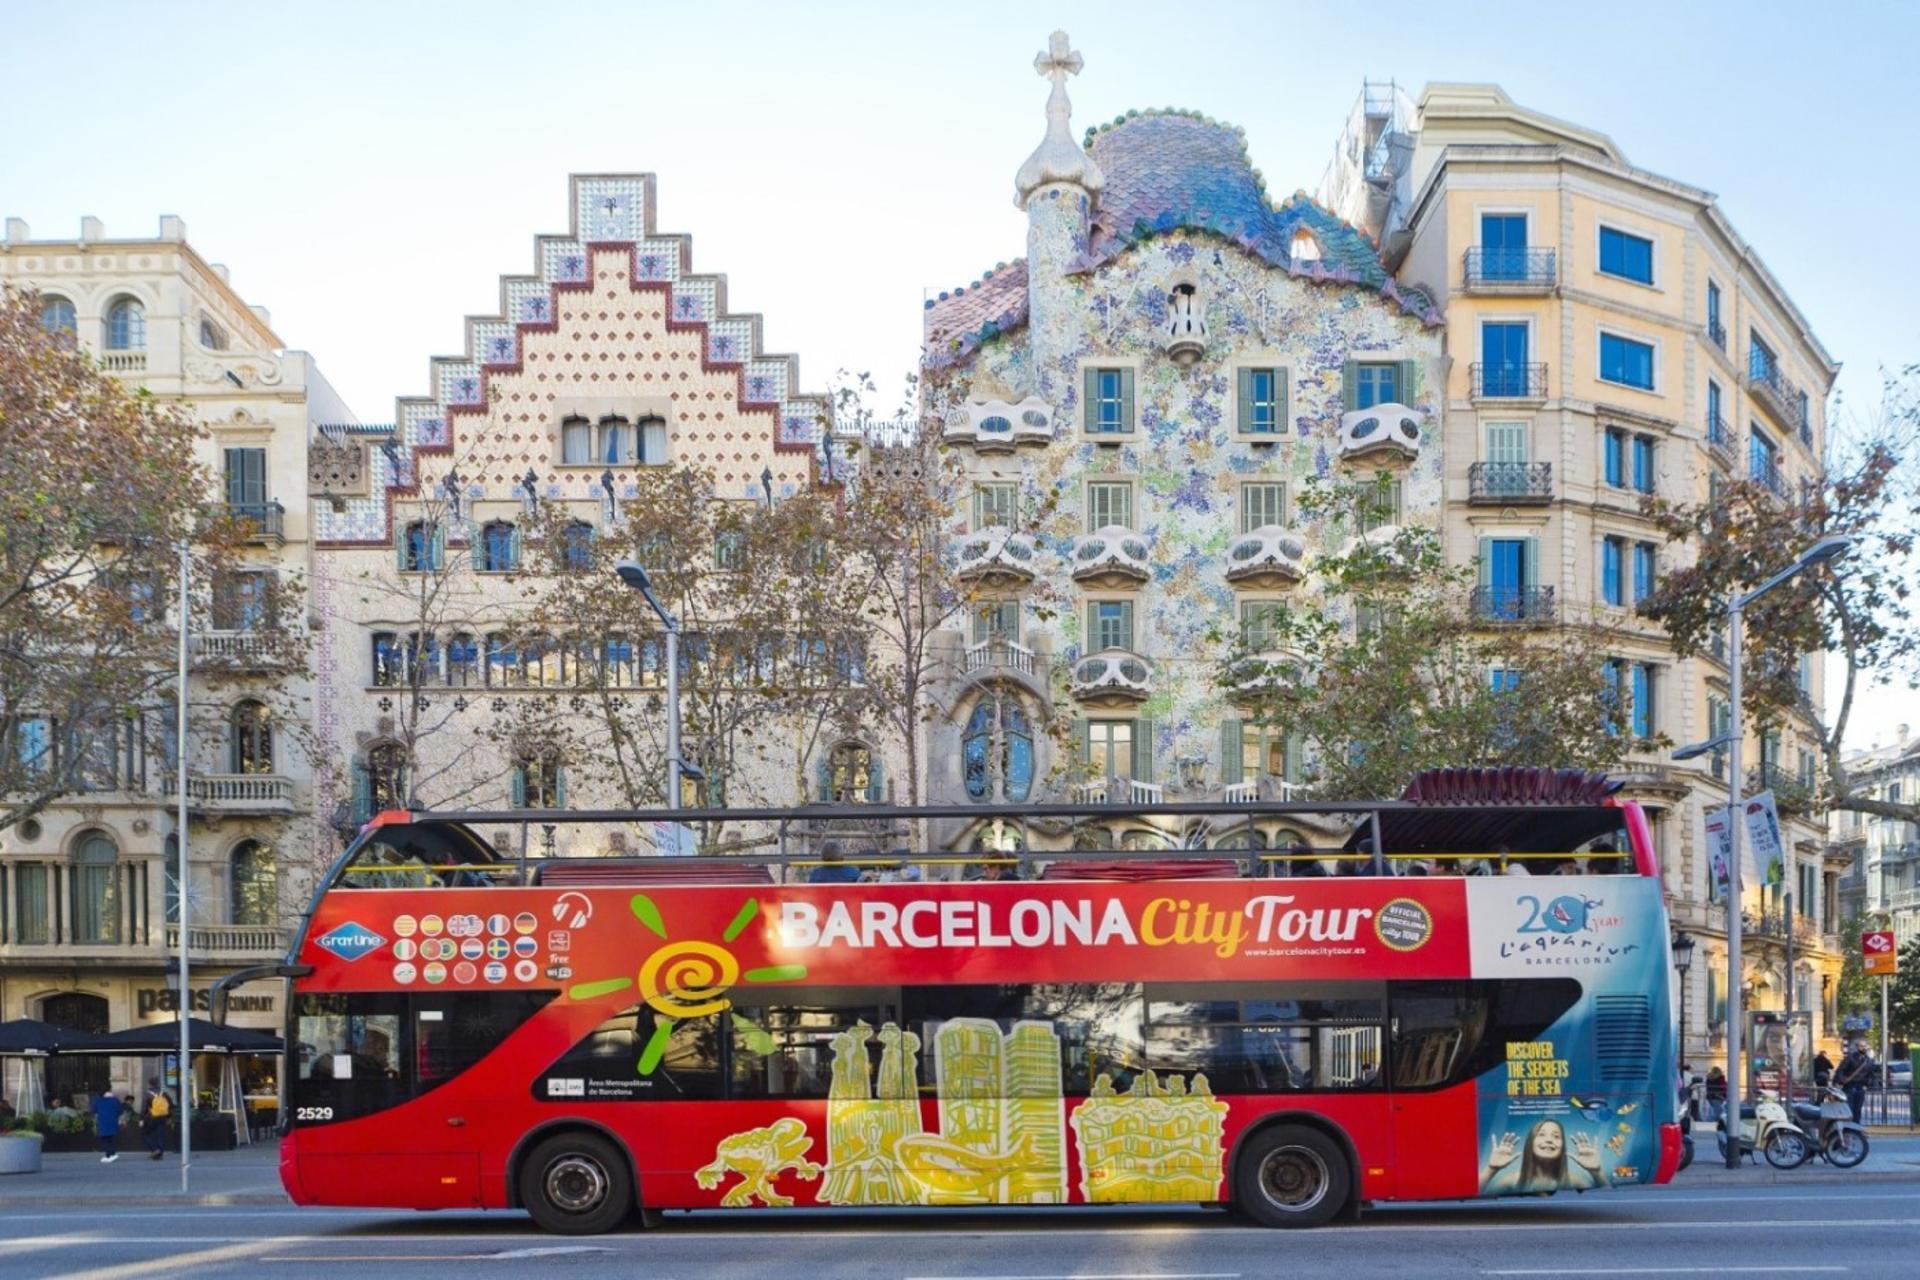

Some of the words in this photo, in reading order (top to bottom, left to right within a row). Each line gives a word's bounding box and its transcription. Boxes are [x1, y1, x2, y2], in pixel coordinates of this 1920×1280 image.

[1390, 906, 1421, 921] OFFICIAL
[782, 899, 1138, 948] BARCELONA
[1140, 898, 1250, 959] City
[1244, 895, 1373, 943] Tour
[1382, 916, 1426, 930] BARCELONA
[1244, 947, 1367, 957] www.barcelonacitytour.es
[1526, 957, 1612, 965] BARCELONA
[228, 996, 274, 1011] COMPANY
[1506, 1042, 1554, 1059] DISCOVER
[1507, 1061, 1525, 1078] THE
[1526, 1060, 1569, 1078] SECRETS
[1508, 1080, 1520, 1096] OF
[1522, 1080, 1541, 1096] THE
[1542, 1080, 1561, 1096] SEA
[297, 1107, 333, 1120] 2529
